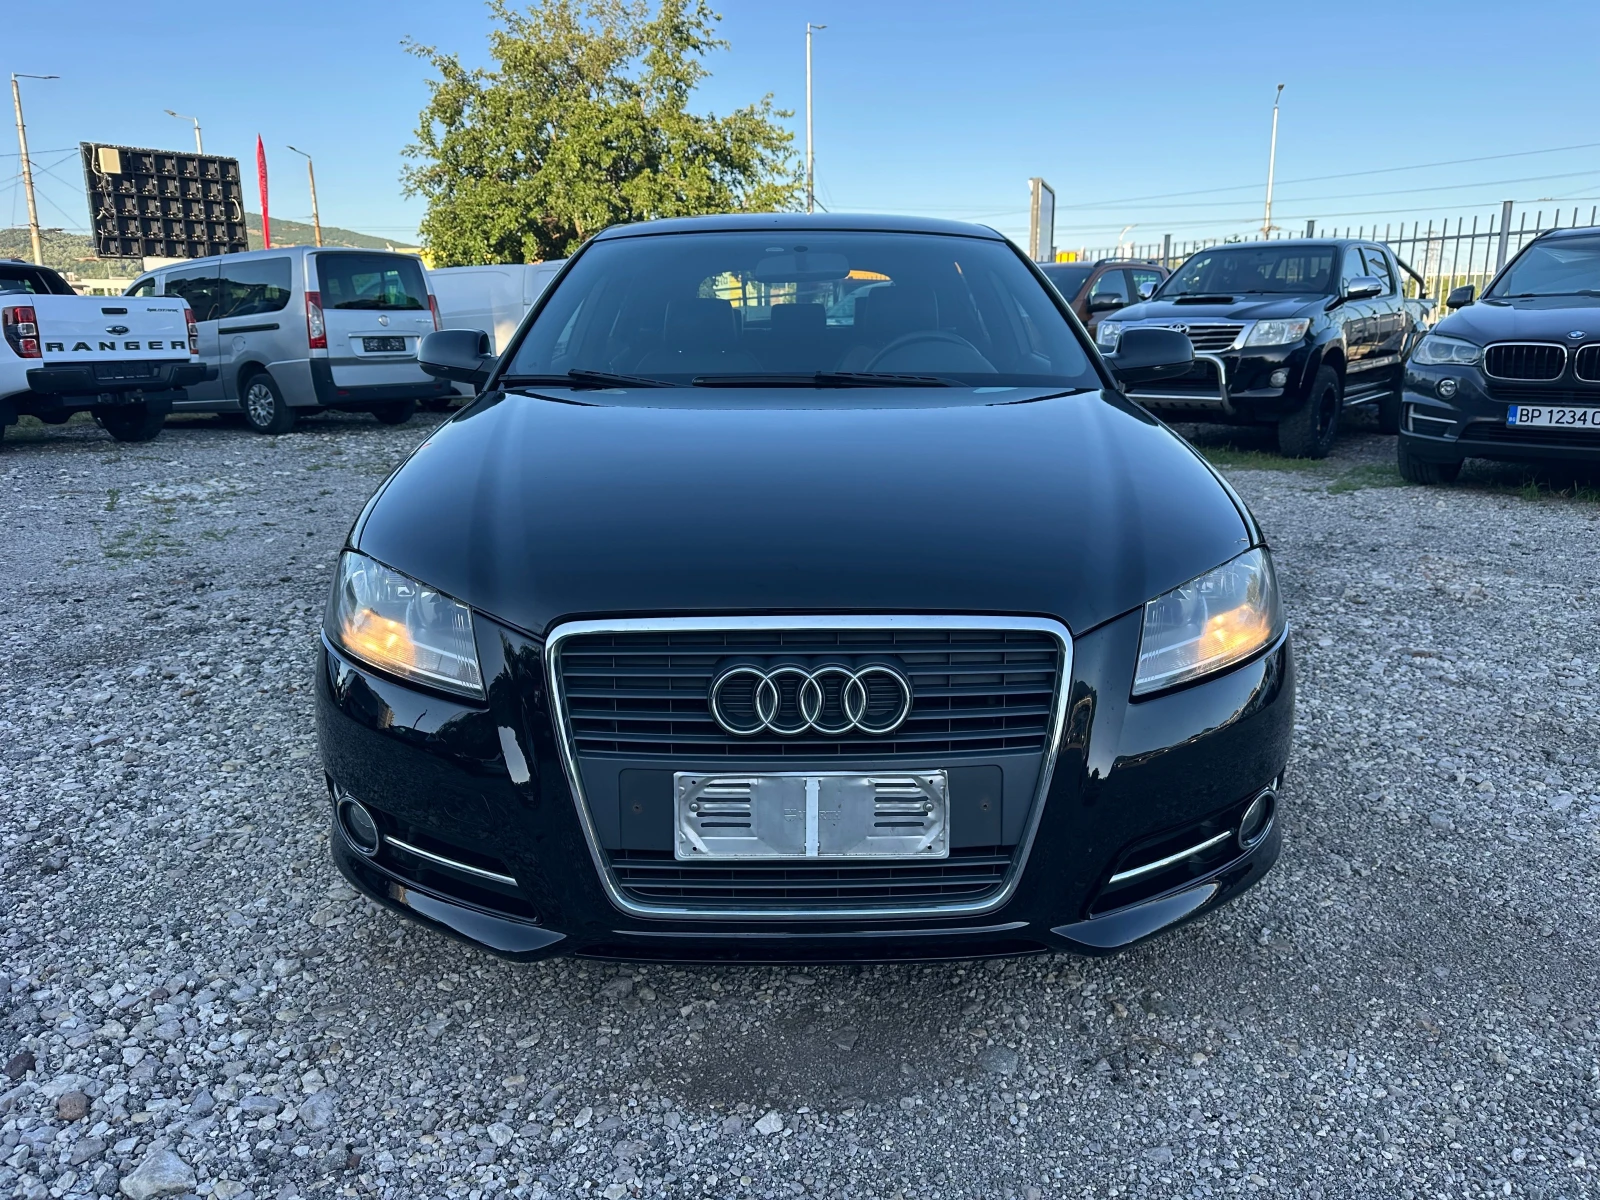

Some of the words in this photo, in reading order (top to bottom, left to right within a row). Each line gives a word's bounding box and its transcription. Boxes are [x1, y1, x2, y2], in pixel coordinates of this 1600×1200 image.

[45, 341, 186, 352] RANGER
[1519, 408, 1542, 423] BP
[1547, 409, 1588, 425] 1234
